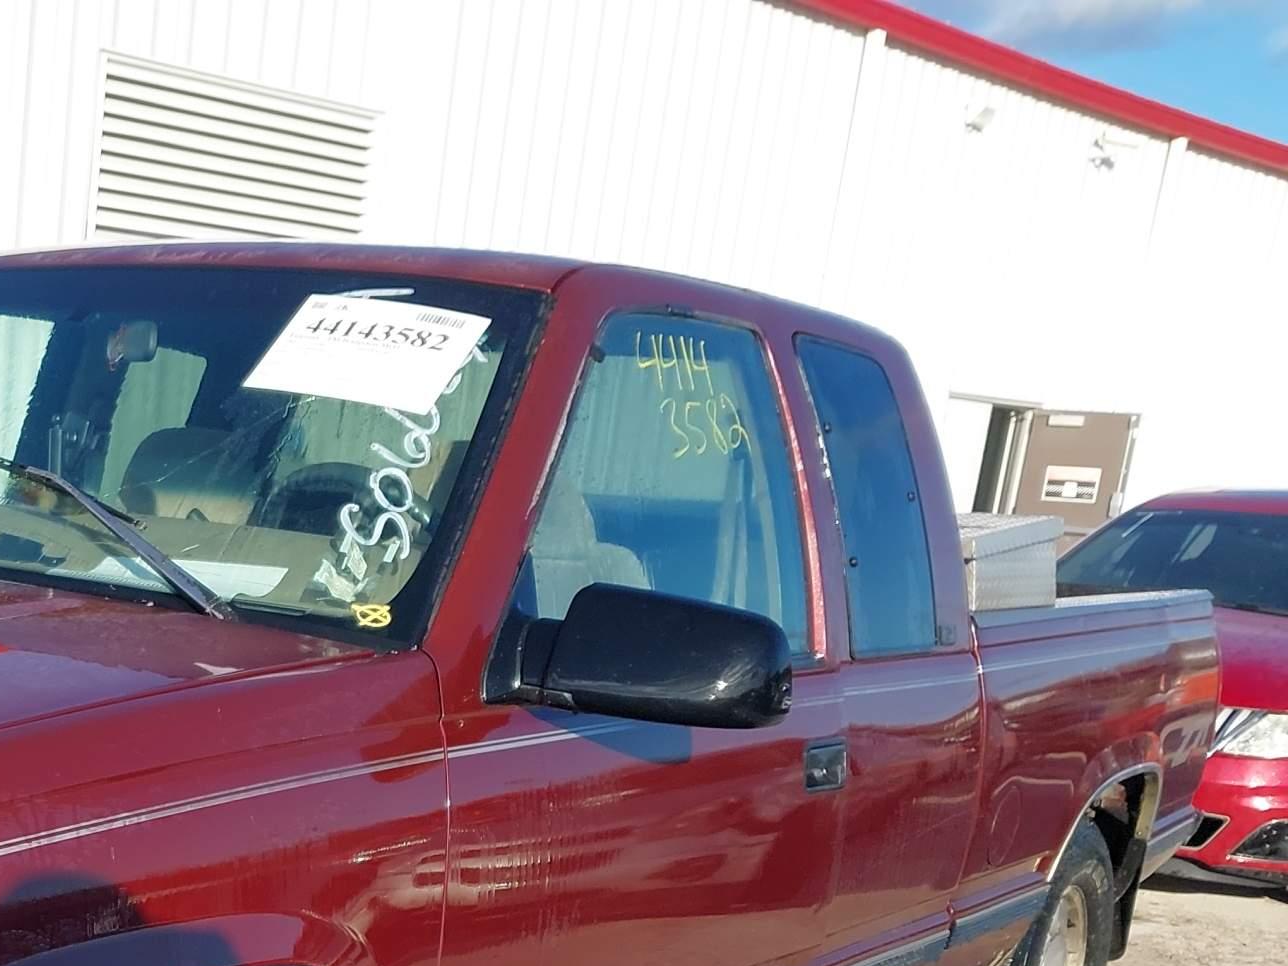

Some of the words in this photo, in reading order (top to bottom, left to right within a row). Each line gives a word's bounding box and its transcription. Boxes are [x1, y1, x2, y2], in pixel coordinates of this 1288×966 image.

[306, 316, 450, 351] 44143582
[636, 331, 713, 396] 4414
[660, 393, 752, 459] 3582
